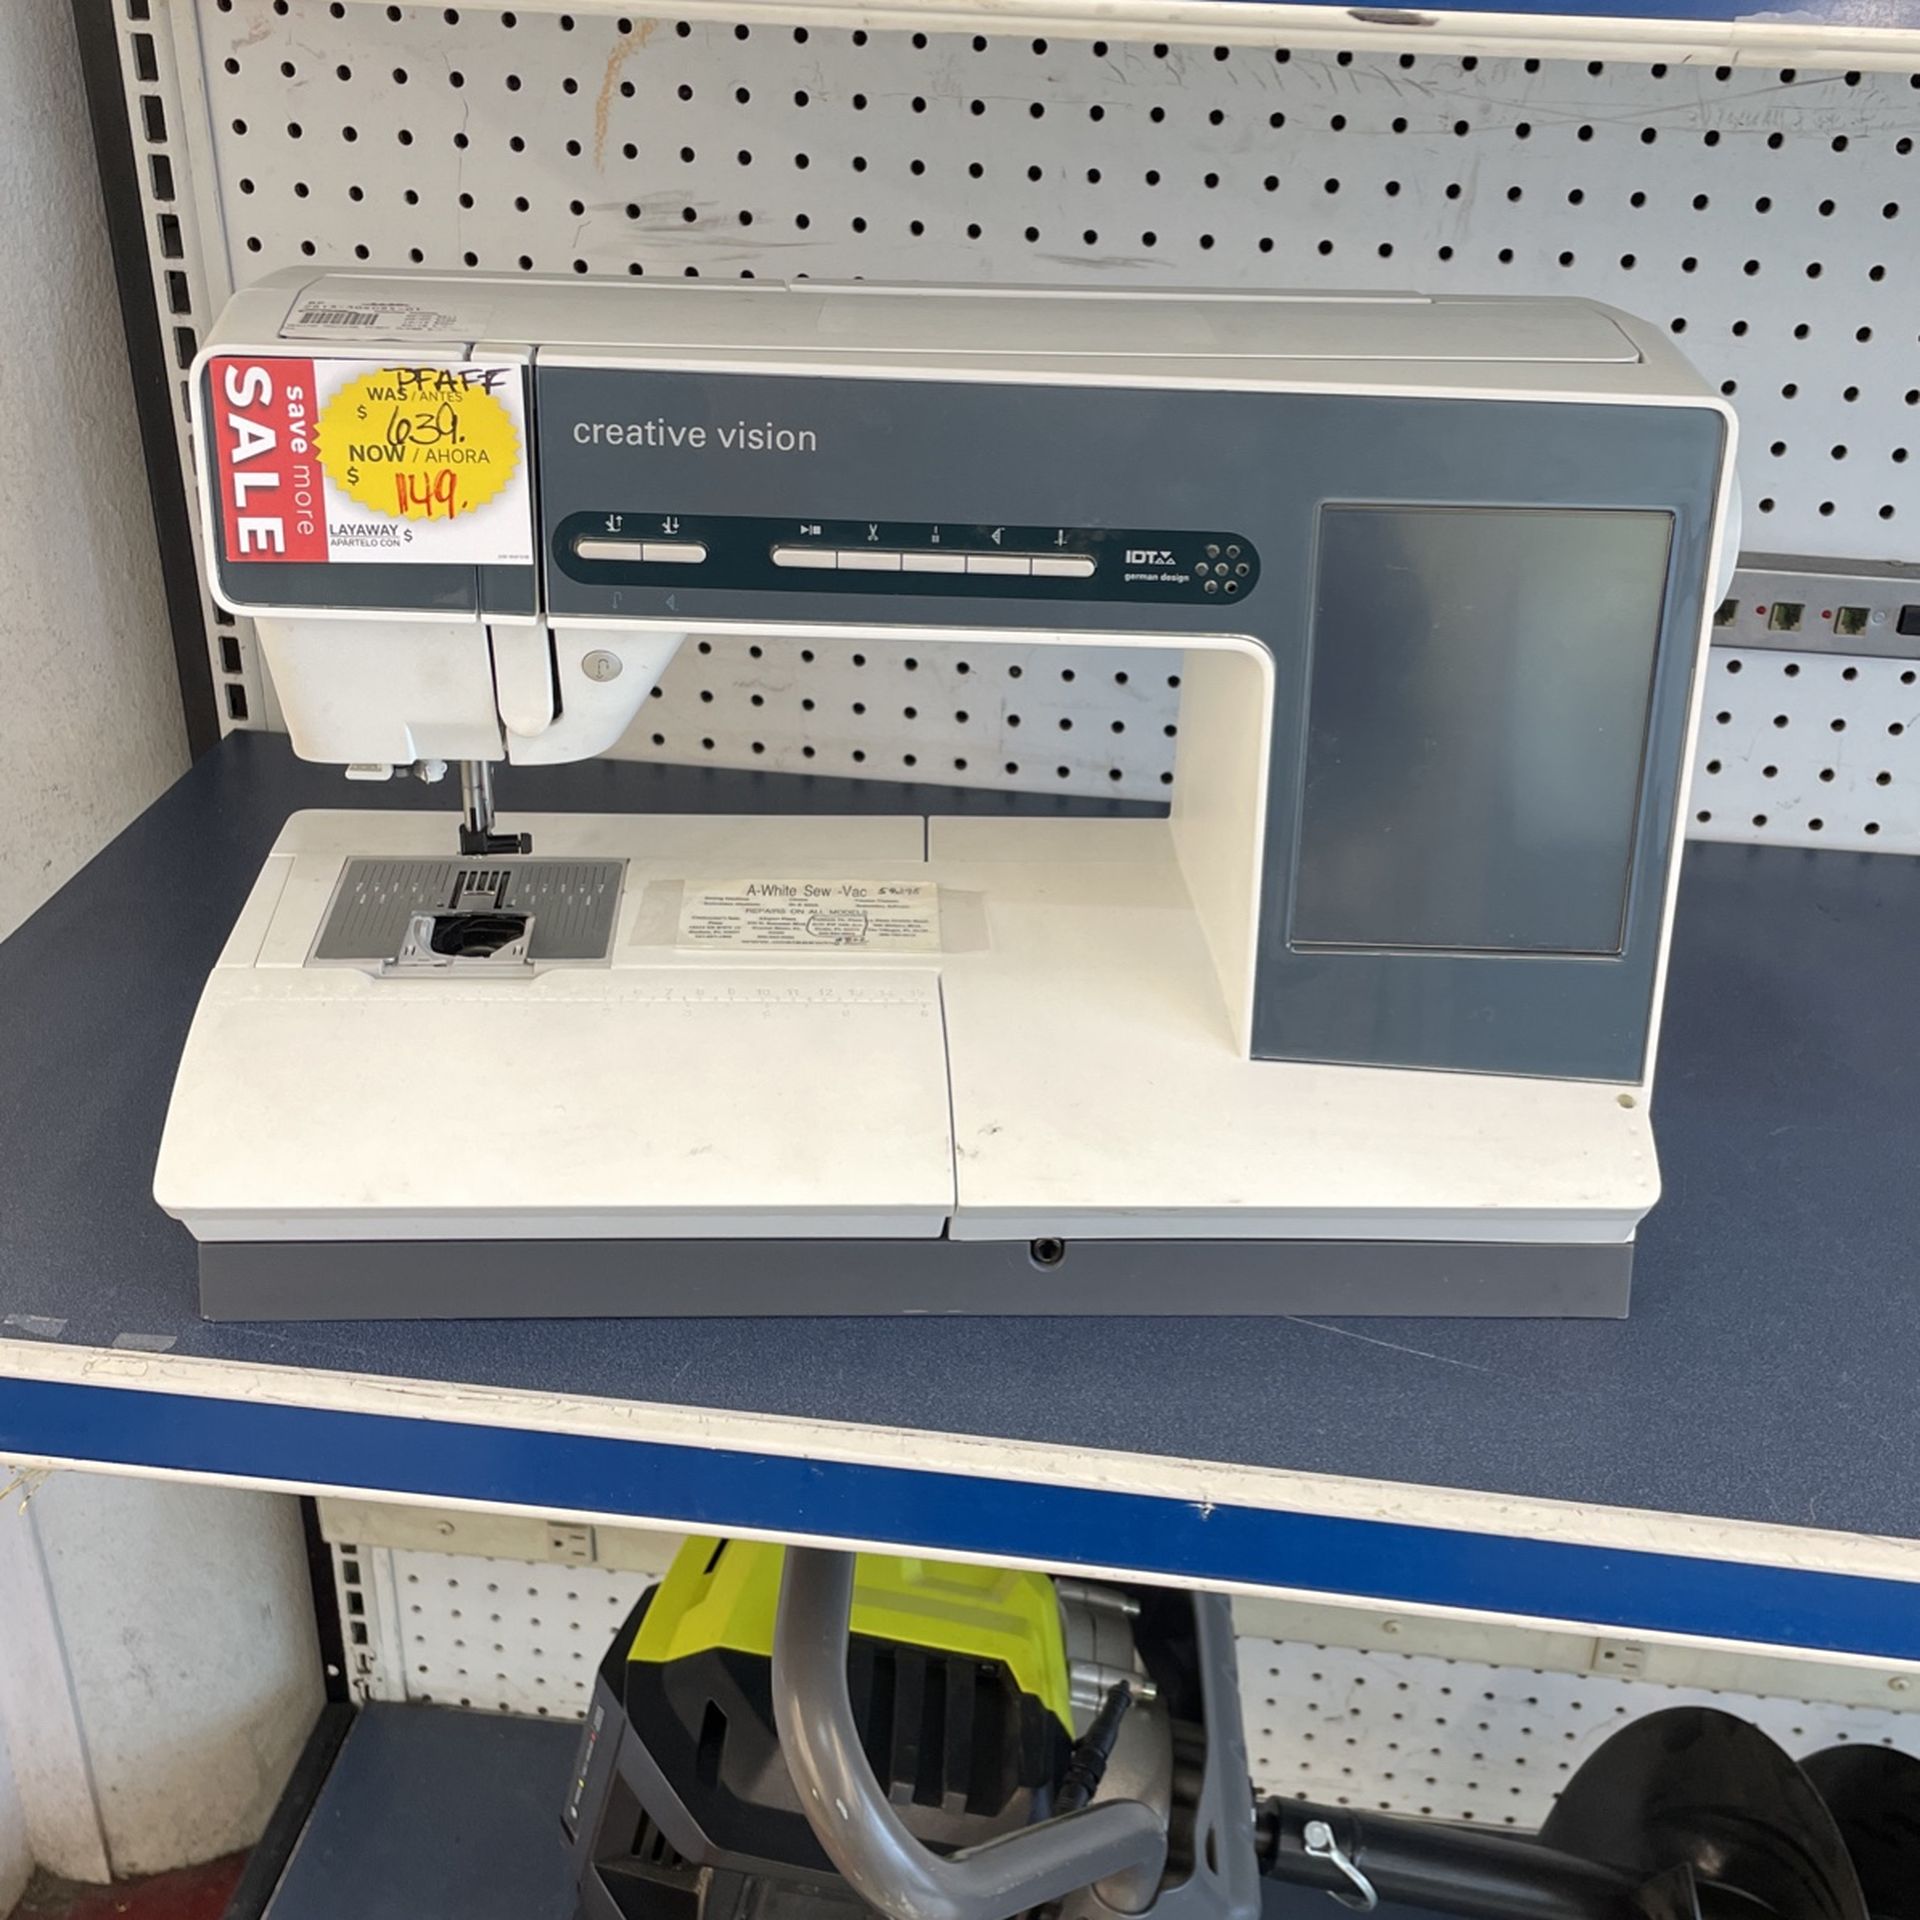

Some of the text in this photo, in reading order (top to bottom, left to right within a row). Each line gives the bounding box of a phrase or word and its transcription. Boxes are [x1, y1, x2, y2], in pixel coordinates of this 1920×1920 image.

[383, 367, 512, 395] PFAFF
[366, 387, 408, 401] WAS
[419, 391, 464, 403] ANTES
[357, 405, 368, 420] $
[573, 418, 818, 453] creative vision
[225, 364, 286, 554] SALE
[286, 386, 315, 536] save more
[349, 444, 406, 463] NOW
[424, 448, 490, 464] AHORA
[346, 466, 359, 485] $
[329, 524, 399, 537] LAYAWAY
[1124, 572, 1191, 584] german design
[745, 882, 798, 897] A-White
[802, 884, 833, 898] Sew
